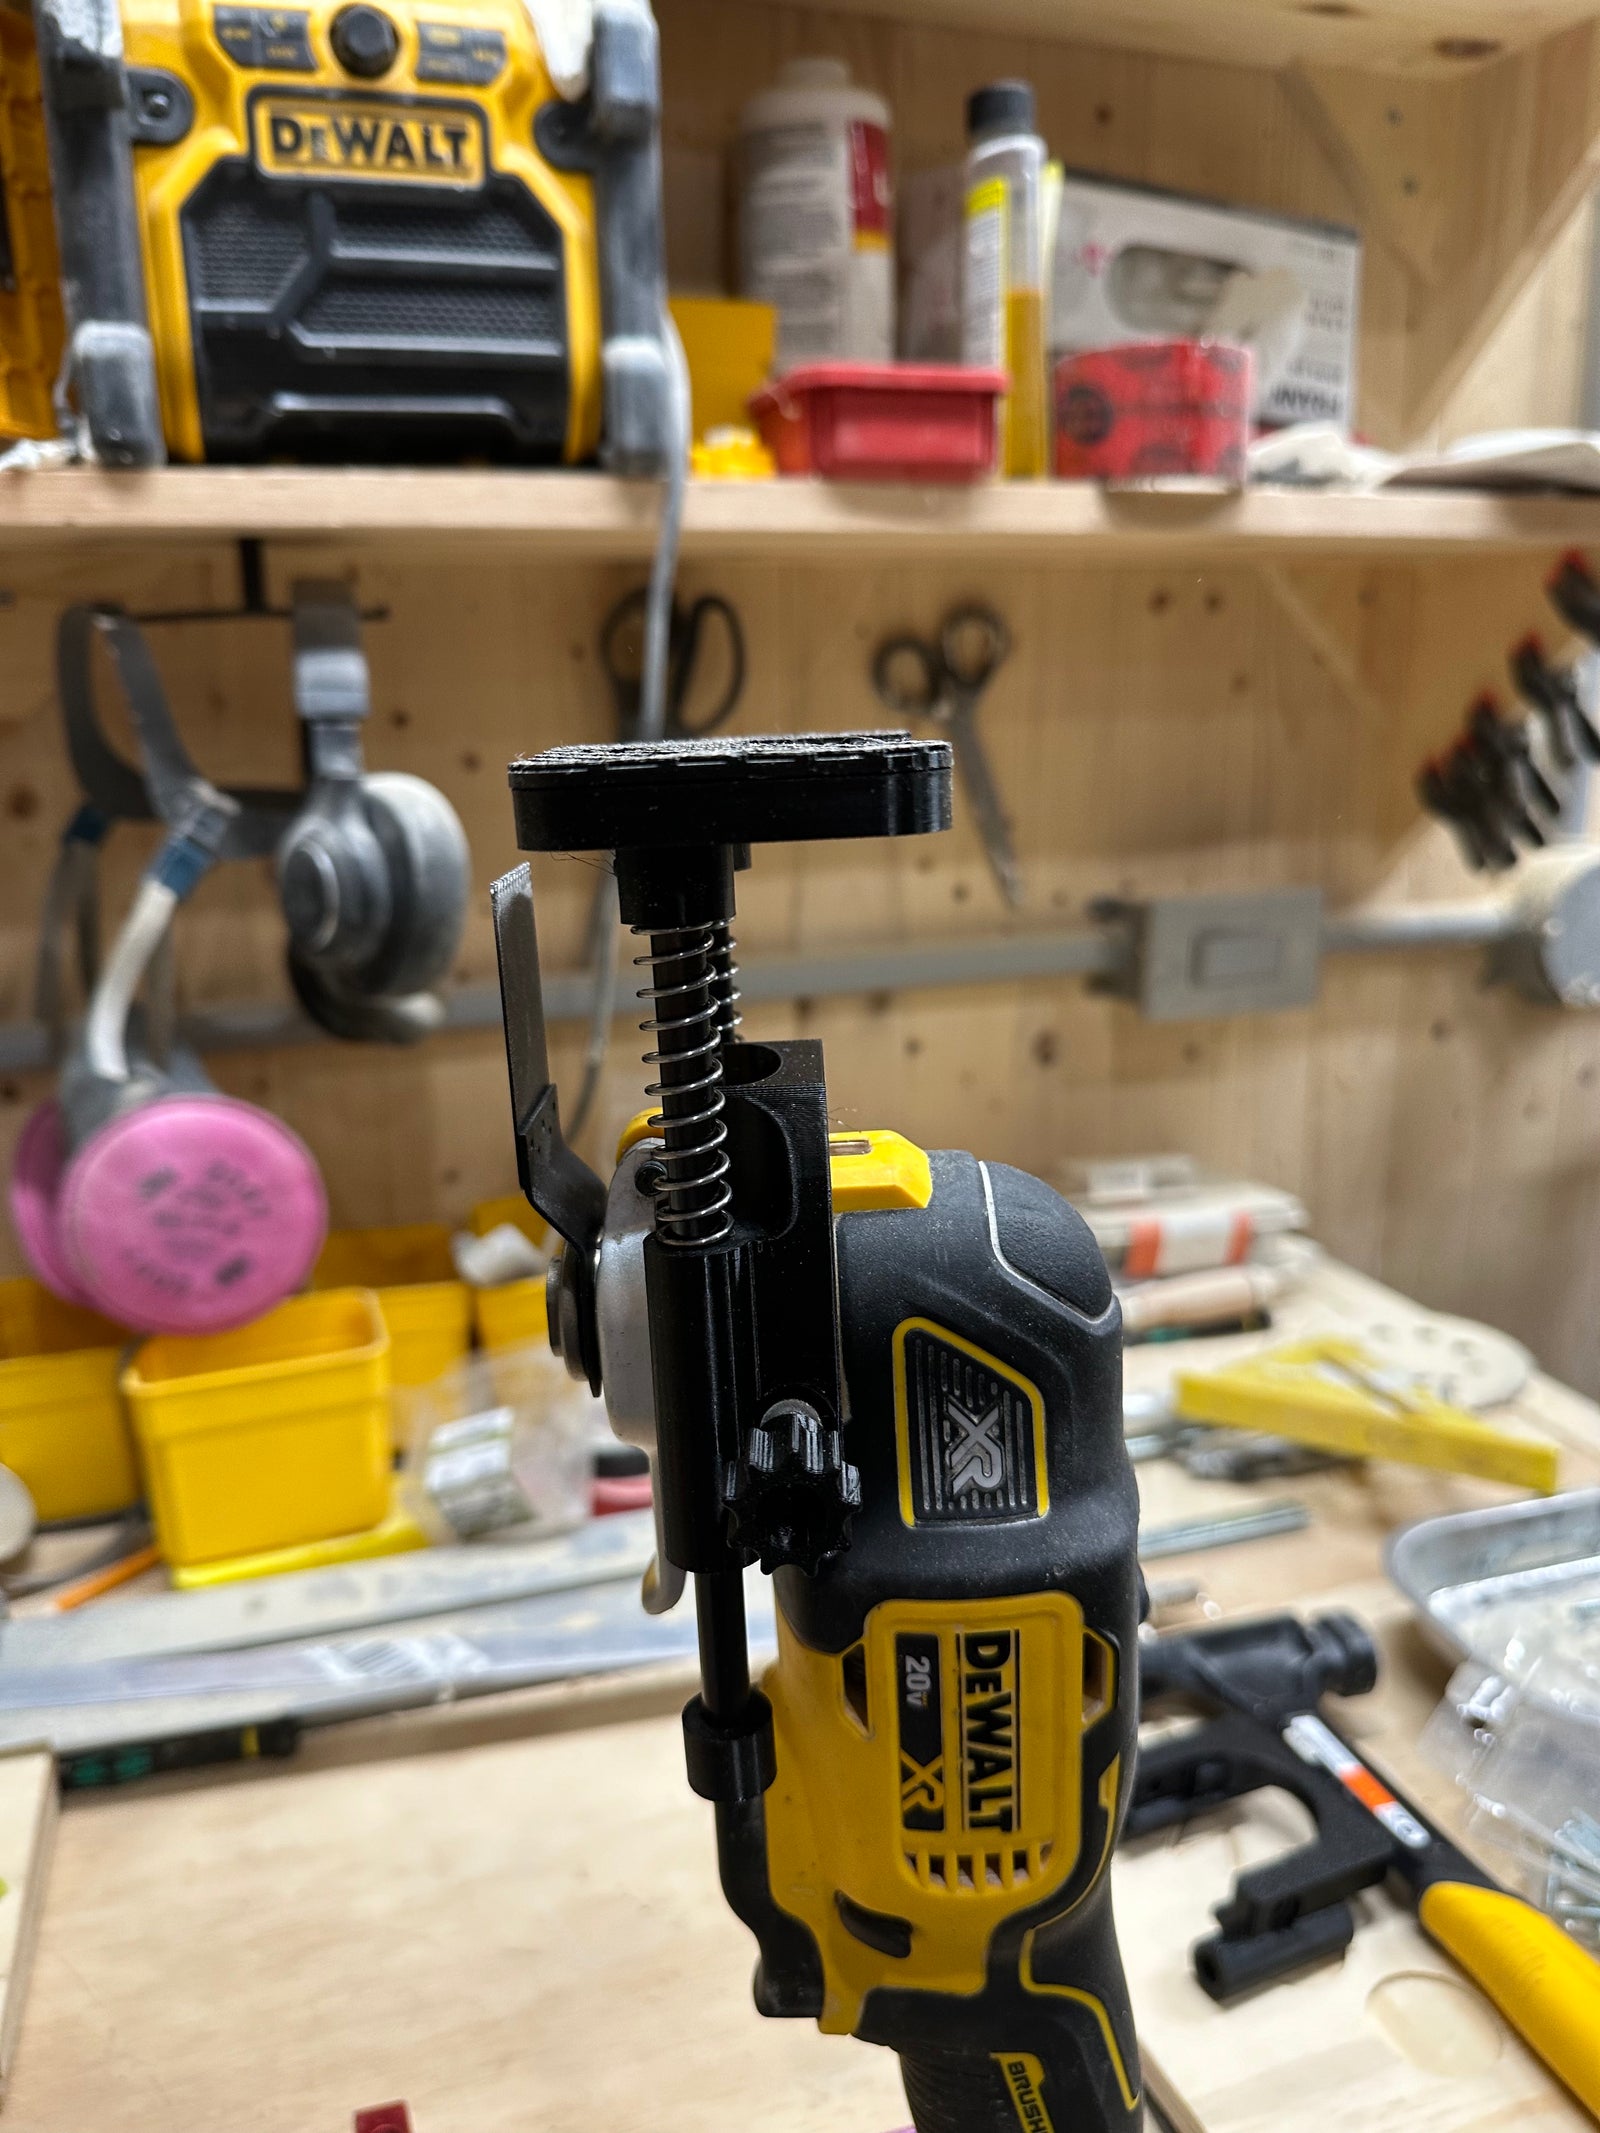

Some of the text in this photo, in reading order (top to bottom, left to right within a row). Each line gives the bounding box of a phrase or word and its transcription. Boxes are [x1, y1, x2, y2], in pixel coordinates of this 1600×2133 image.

[948, 1403, 1004, 1494] XR
[901, 1748, 945, 1811] XR
[1008, 2061, 1048, 2133] BRUSH
